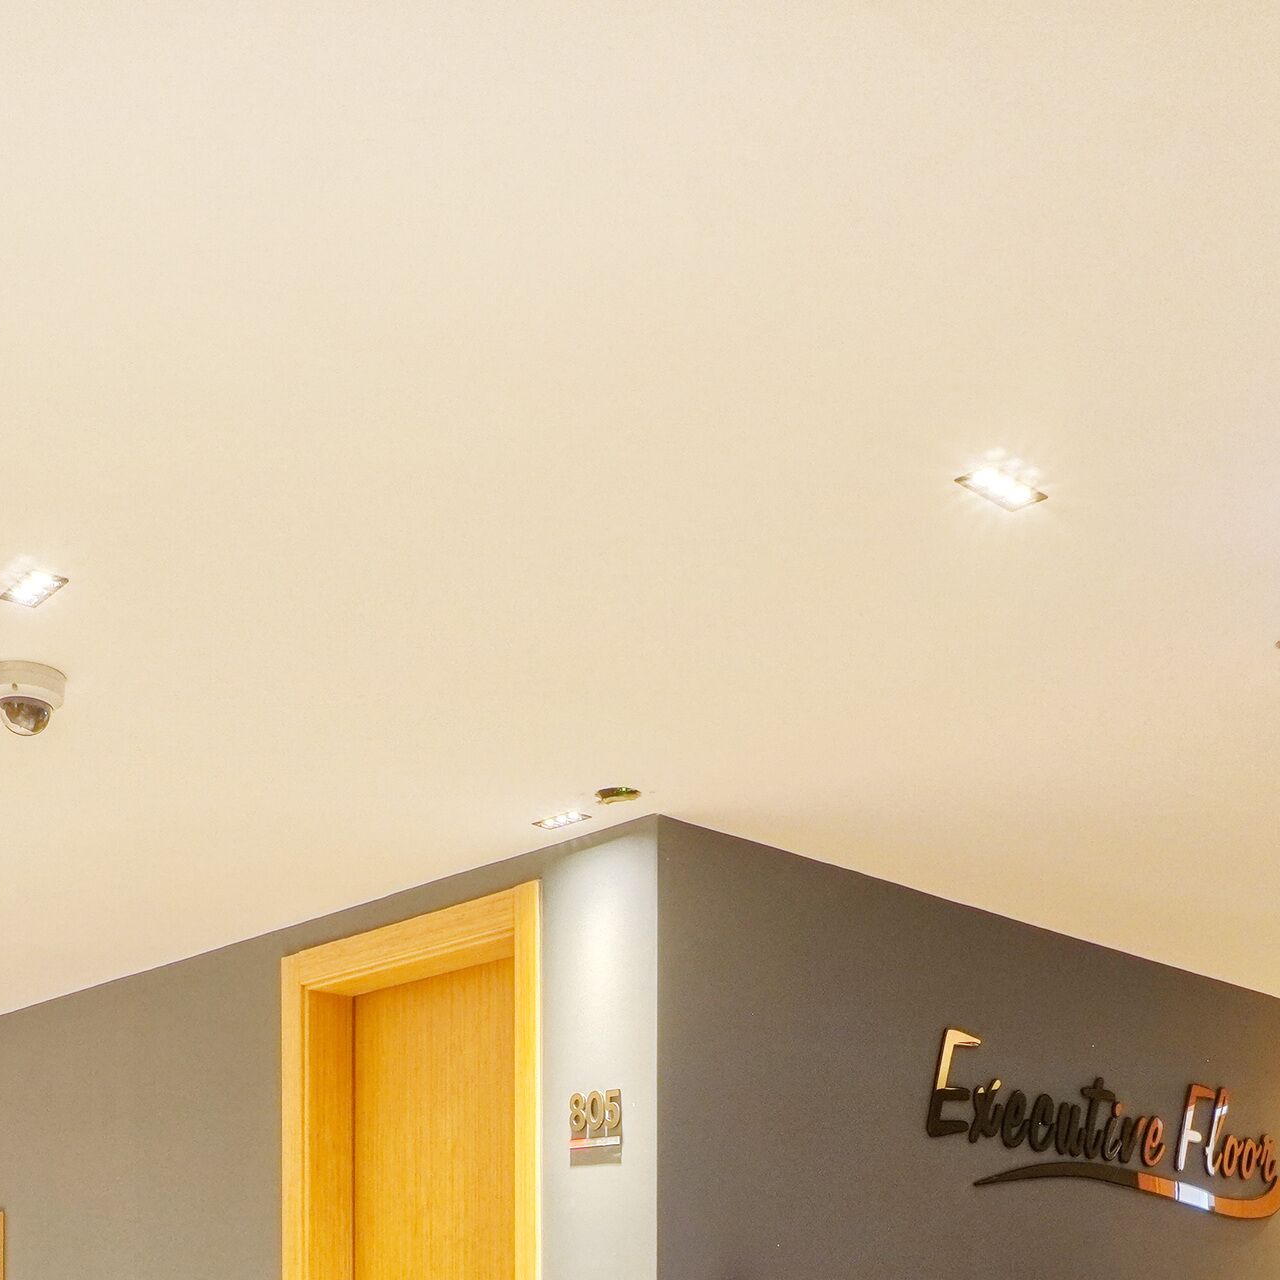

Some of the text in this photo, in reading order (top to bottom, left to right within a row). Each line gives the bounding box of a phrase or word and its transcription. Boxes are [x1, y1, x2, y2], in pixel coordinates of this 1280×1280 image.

[569, 1089, 622, 1132] 805
[927, 1028, 1277, 1184] Executive Floor
